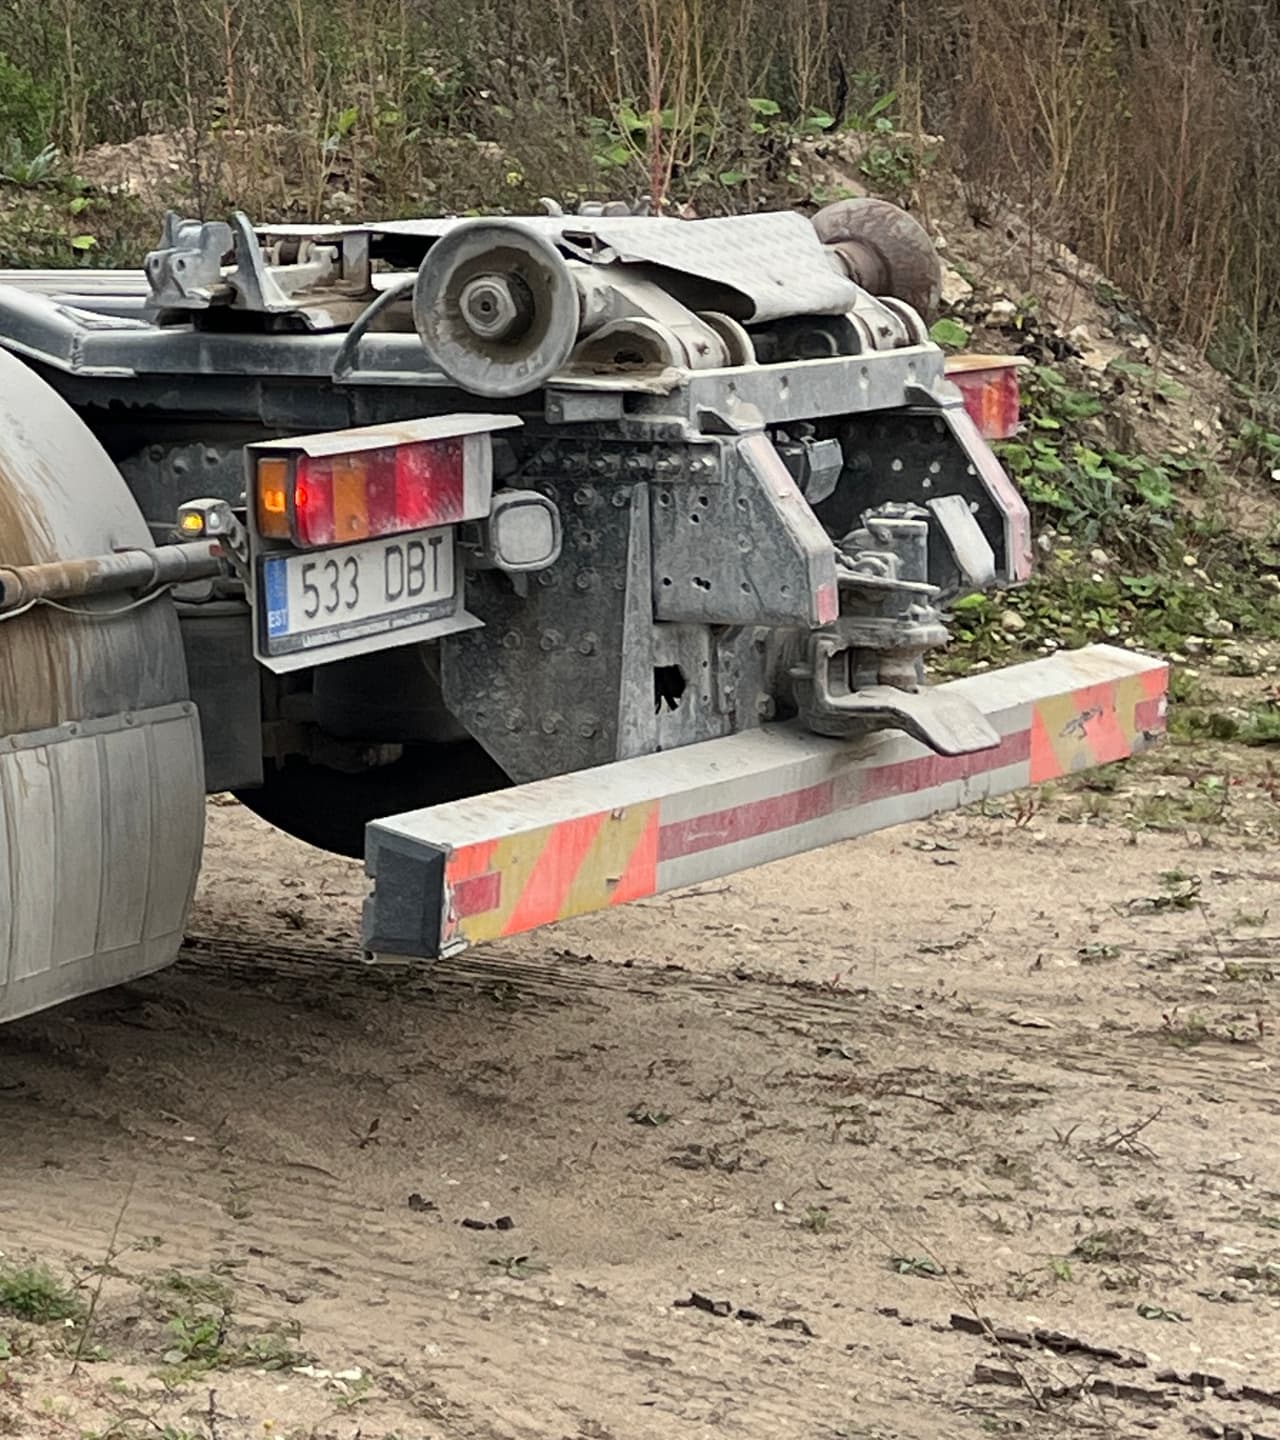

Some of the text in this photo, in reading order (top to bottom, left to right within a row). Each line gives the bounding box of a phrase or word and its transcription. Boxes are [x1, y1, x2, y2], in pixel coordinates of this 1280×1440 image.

[301, 536, 443, 619] 533 DBT
[268, 610, 288, 628] EST
